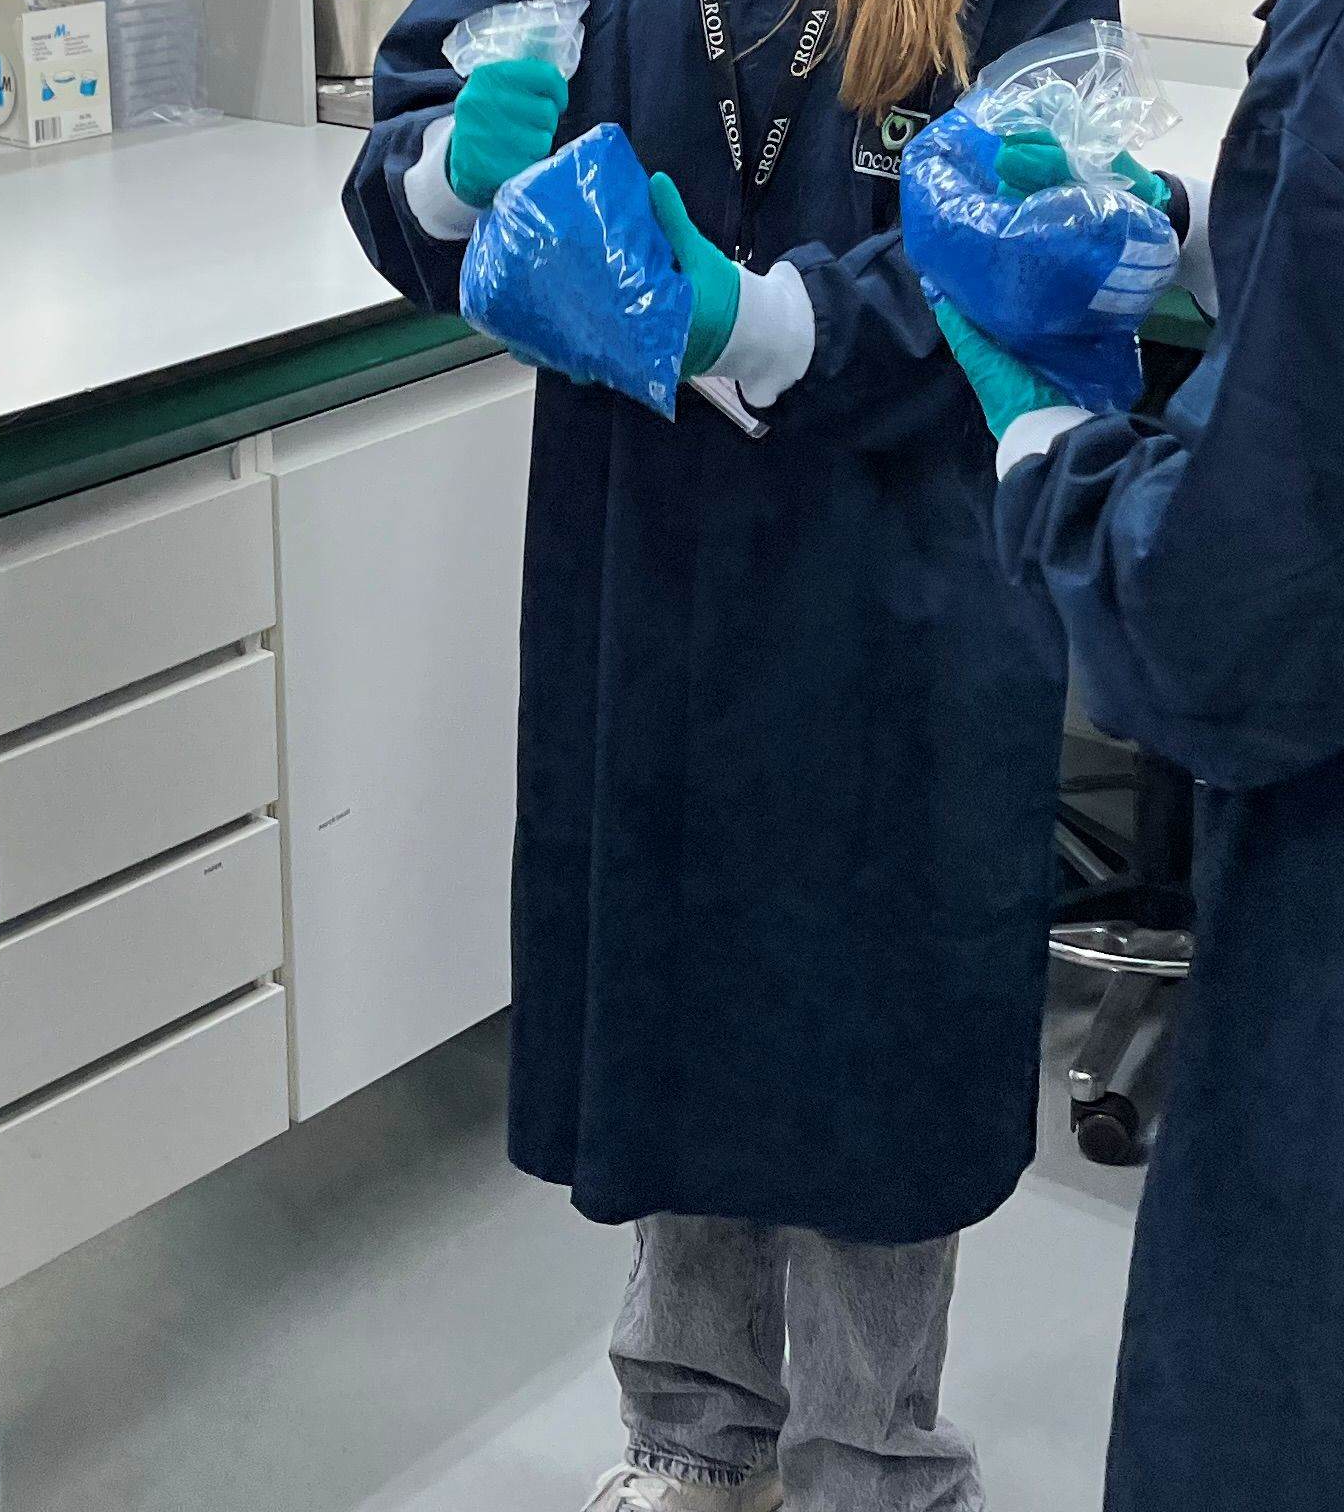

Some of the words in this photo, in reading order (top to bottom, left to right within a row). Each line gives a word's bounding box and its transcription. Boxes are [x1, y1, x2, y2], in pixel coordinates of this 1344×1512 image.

[790, 9, 829, 79] CRODA
[719, 99, 742, 171] CRODA
[754, 117, 791, 186] CRODA
[857, 144, 901, 174] incot
